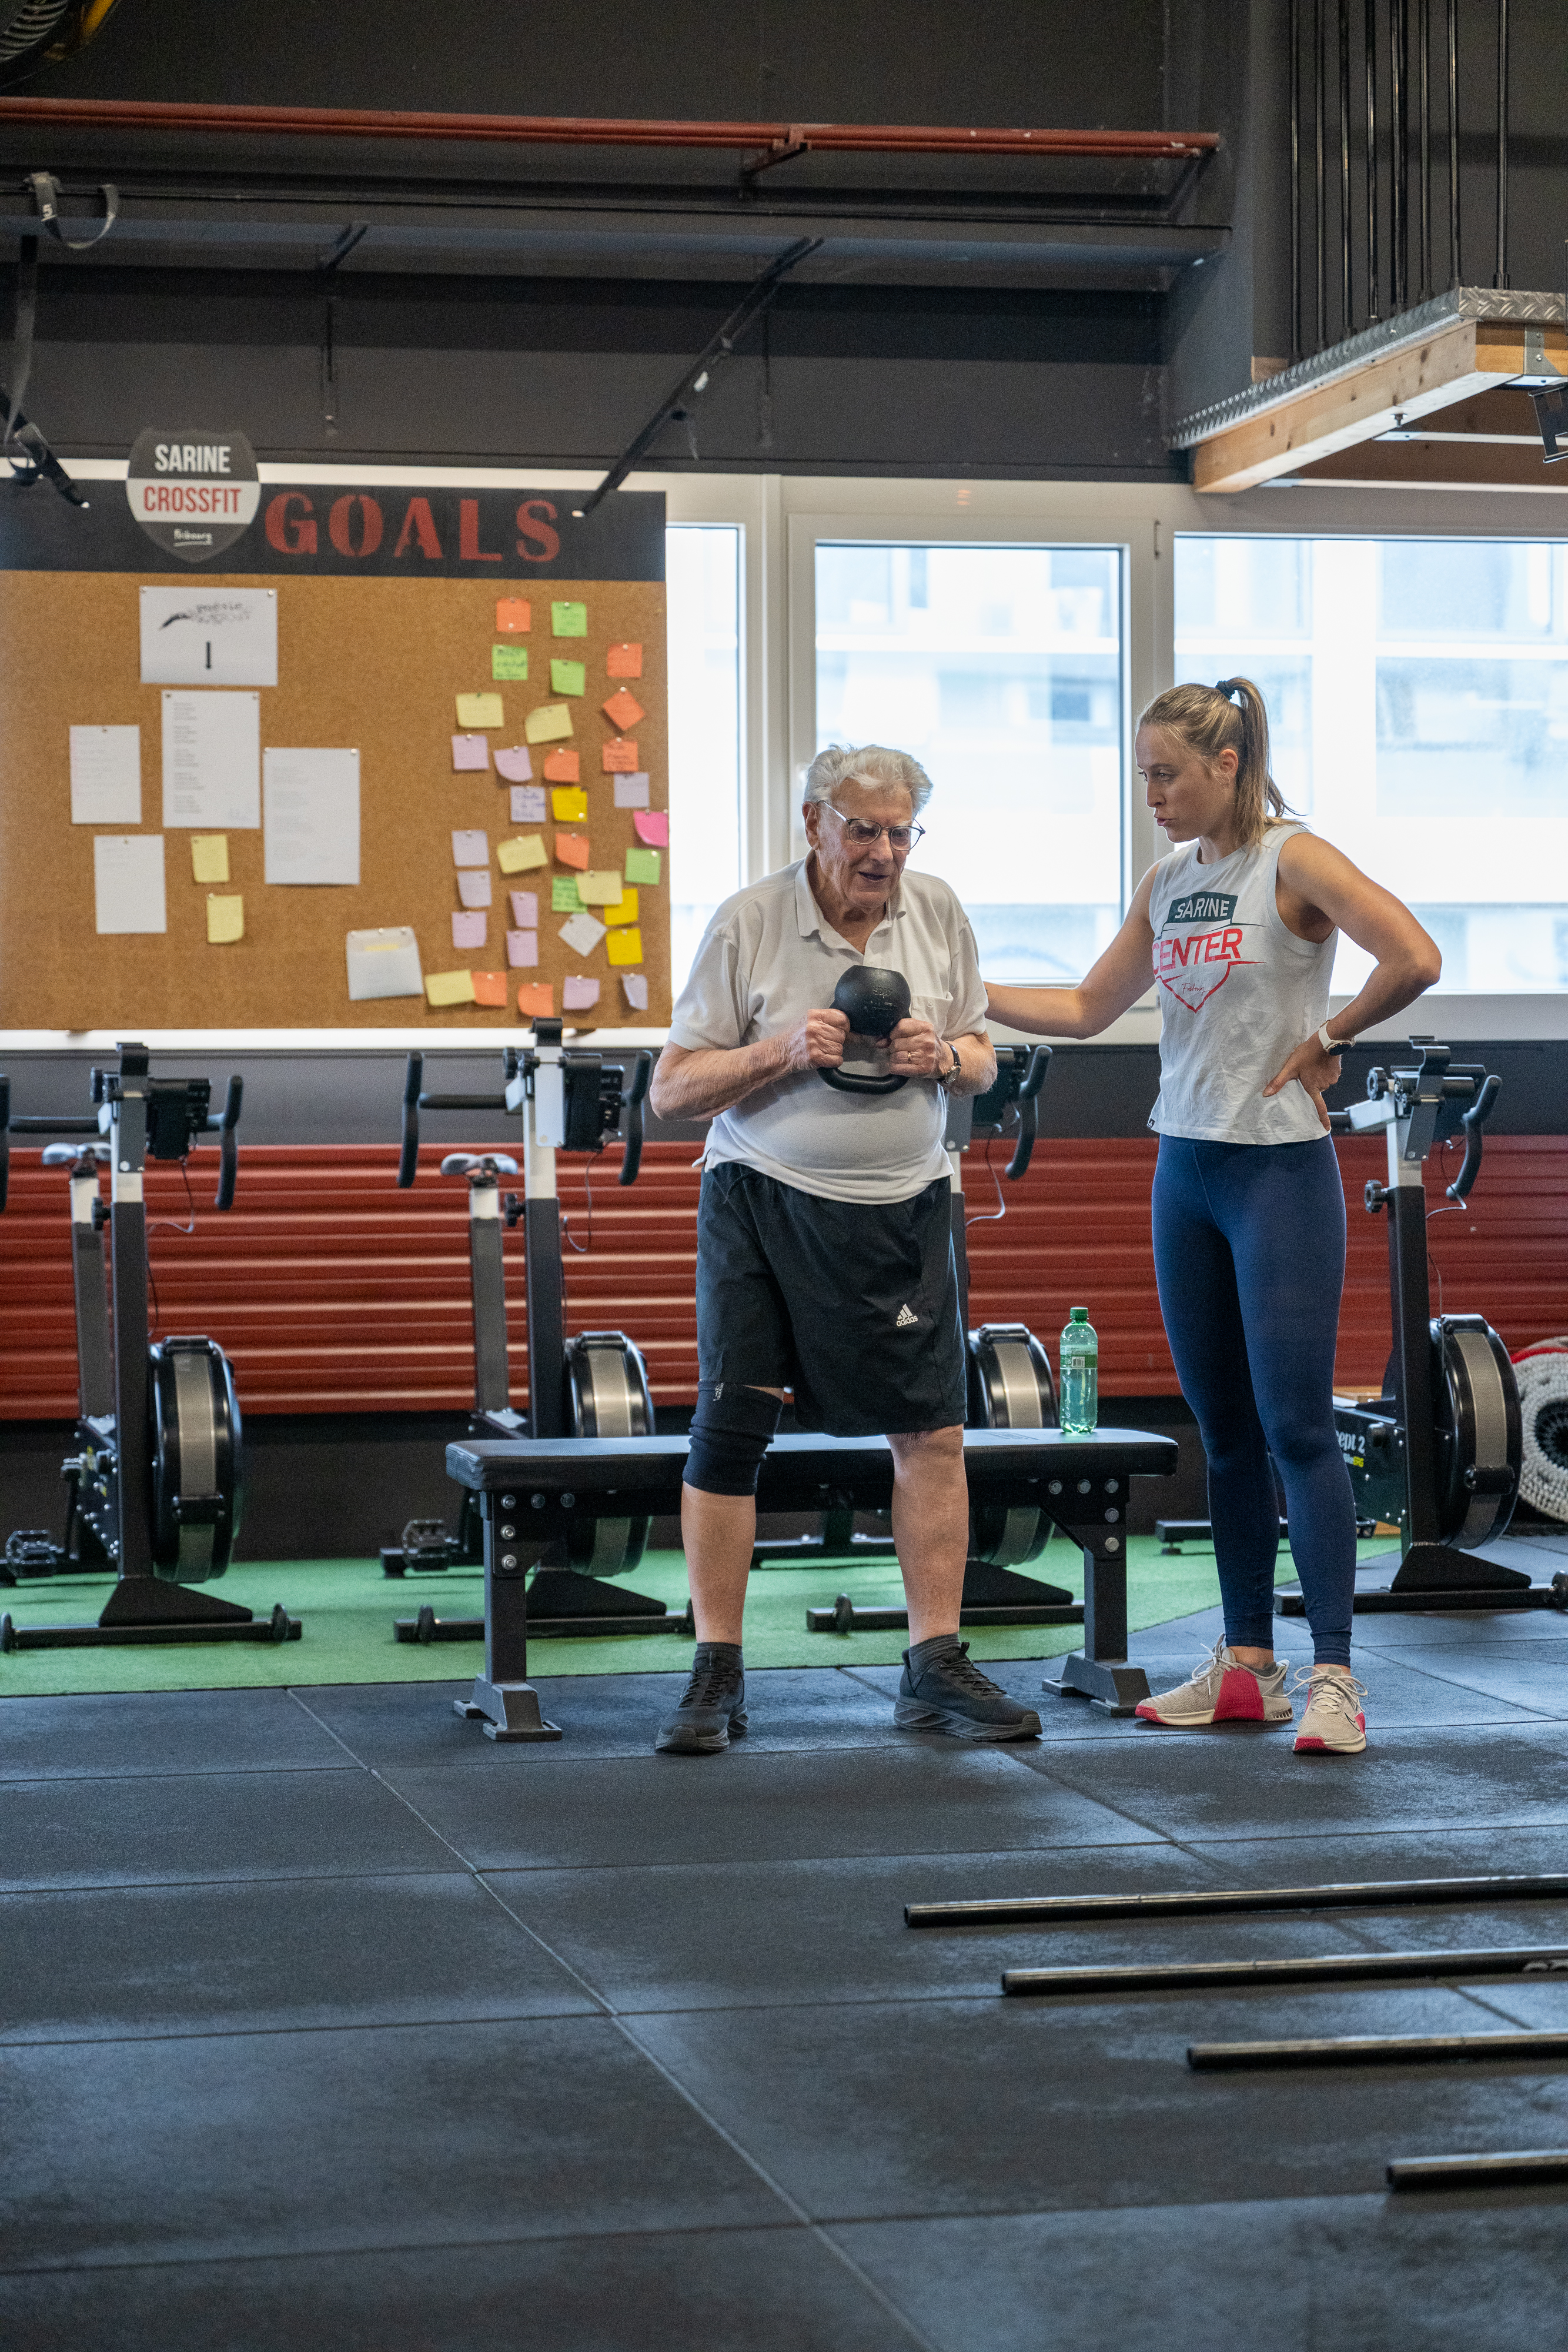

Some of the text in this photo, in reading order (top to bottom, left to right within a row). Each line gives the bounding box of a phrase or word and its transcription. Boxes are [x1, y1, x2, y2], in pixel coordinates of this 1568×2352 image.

[155, 444, 231, 473] SARINE
[143, 486, 241, 513] CROSSFIT
[265, 492, 560, 562] GOALS
[1175, 897, 1230, 919] SARINE
[1152, 928, 1243, 975] CENTER
[896, 1315, 918, 1327] adidas
[1358, 1435, 1365, 1454] 2
